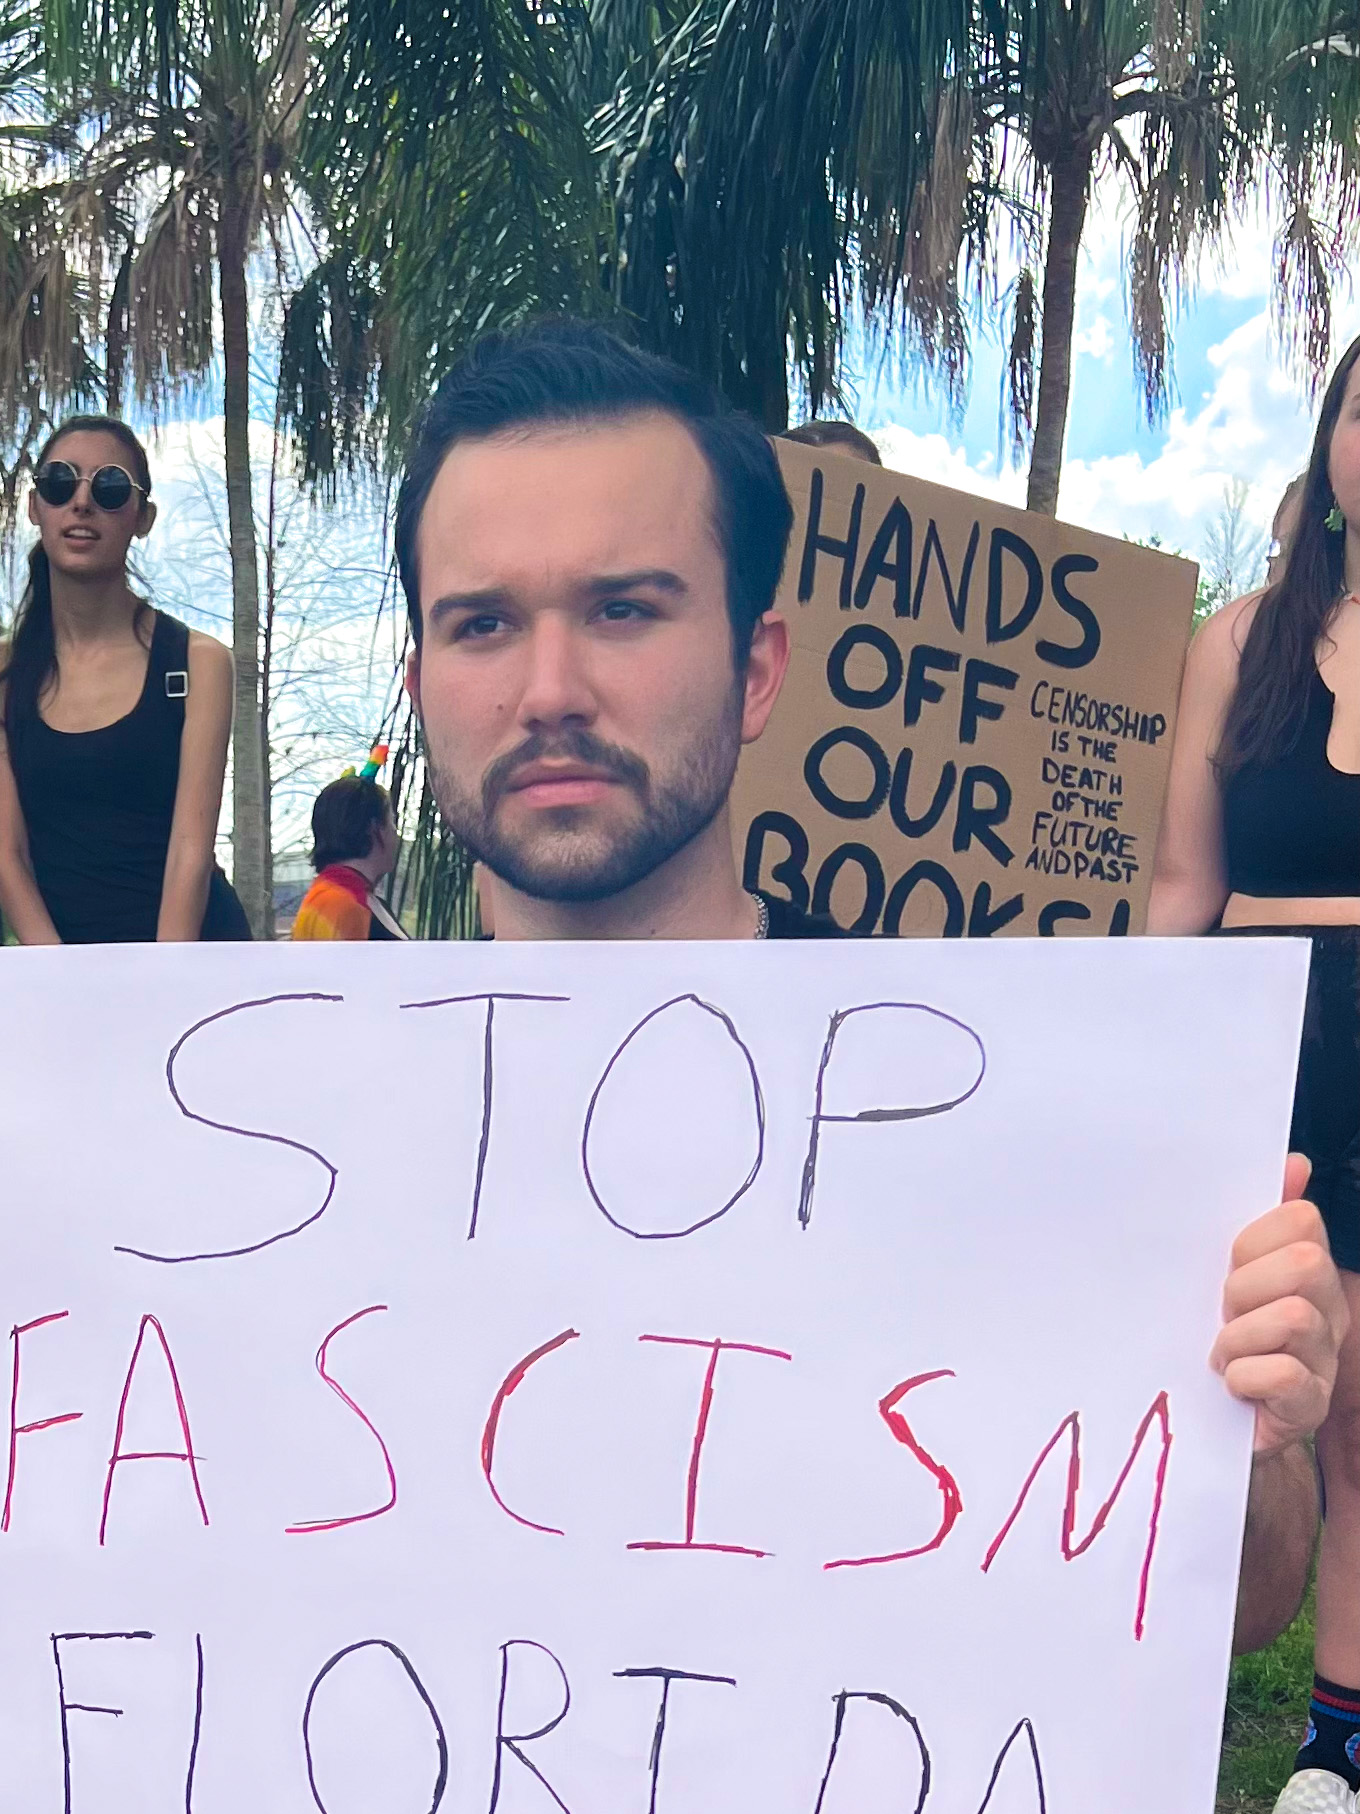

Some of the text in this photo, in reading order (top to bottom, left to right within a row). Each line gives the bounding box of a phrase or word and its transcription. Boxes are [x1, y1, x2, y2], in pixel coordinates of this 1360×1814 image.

[798, 467, 1102, 668] HANDS
[826, 623, 1021, 744] OFF
[1030, 680, 1167, 744] CENSORSHIP
[803, 725, 1015, 868] OUR
[1041, 757, 1123, 795] DEATH
[1051, 730, 1118, 763] IS THE
[1031, 810, 1138, 861] FUTURE
[114, 993, 986, 1262] STOP
[0, 1304, 1173, 1642] FASCISM
